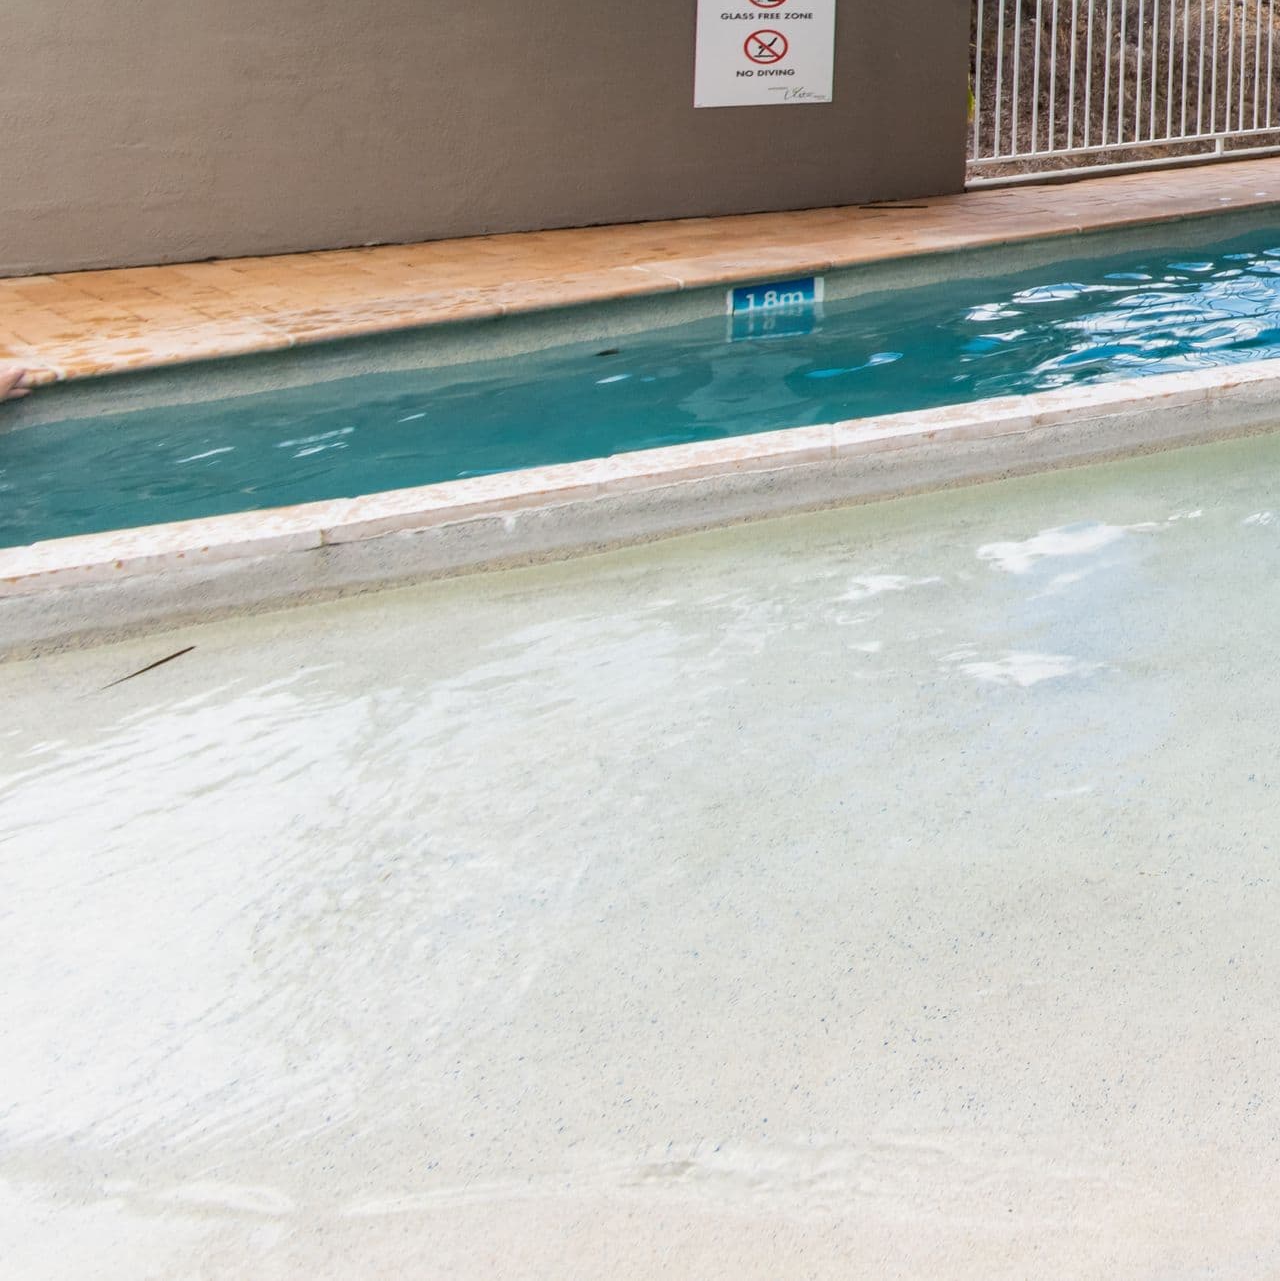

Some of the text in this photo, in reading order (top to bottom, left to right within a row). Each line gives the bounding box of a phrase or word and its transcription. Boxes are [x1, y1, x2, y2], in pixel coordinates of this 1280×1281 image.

[720, 12, 813, 20] GLASS FREE ZONE
[736, 68, 796, 78] NO DIVING
